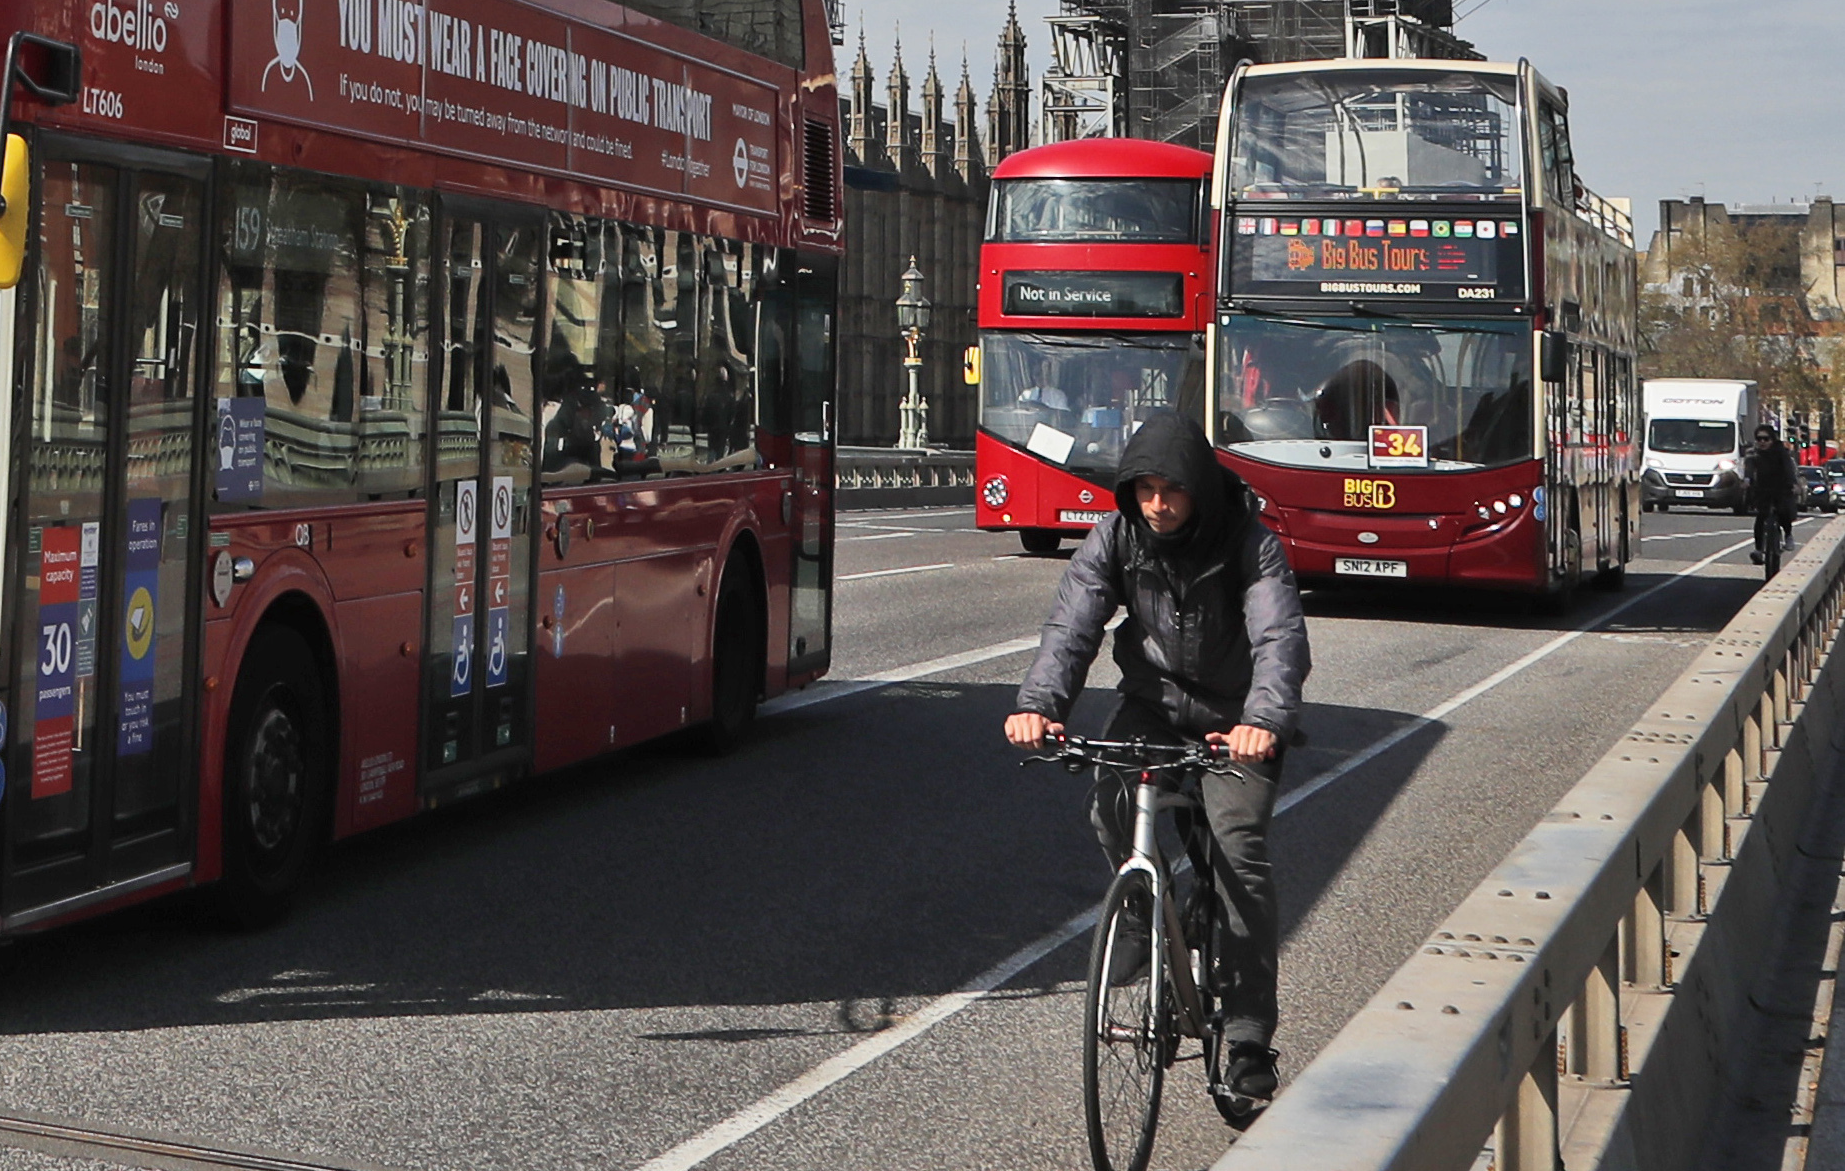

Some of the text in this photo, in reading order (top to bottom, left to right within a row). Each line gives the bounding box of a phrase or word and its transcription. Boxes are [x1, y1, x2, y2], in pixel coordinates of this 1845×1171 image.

[135, 55, 164, 75] london
[429, 10, 471, 79] WEAR
[475, 24, 486, 83] A
[490, 28, 522, 92] FACE
[590, 59, 606, 114] ON
[610, 65, 650, 126] PUBLIC
[652, 77, 712, 141] TRANSPORT
[83, 86, 124, 119] LT606
[339, 73, 348, 97] If
[349, 81, 368, 104] you
[369, 81, 383, 104] do
[384, 89, 404, 110] not,
[405, 94, 422, 115] you
[425, 98, 444, 122] may
[445, 98, 456, 121] be
[457, 103, 485, 129] turned
[486, 112, 506, 136] away
[507, 112, 527, 135] from
[528, 117, 541, 139] the
[573, 131, 586, 149] and
[231, 122, 252, 145] global
[235, 207, 260, 250] 159
[1322, 239, 1430, 271] Big Bus Tours
[1020, 285, 1112, 302] Not in Service
[1321, 282, 1421, 295] BIGBUSTOURS.COM
[1458, 287, 1495, 300] DA231
[1388, 433, 1422, 456] 34
[1344, 478, 1373, 494] BIG
[1344, 493, 1373, 508] BUS
[132, 518, 156, 533] Fares in
[128, 537, 158, 552] operation
[44, 548, 77, 563] Maximum
[1343, 560, 1399, 574] SN12 APF
[45, 568, 75, 583] capacity
[41, 622, 72, 676] 30
[39, 685, 72, 701] passengers
[124, 691, 134, 703] You
